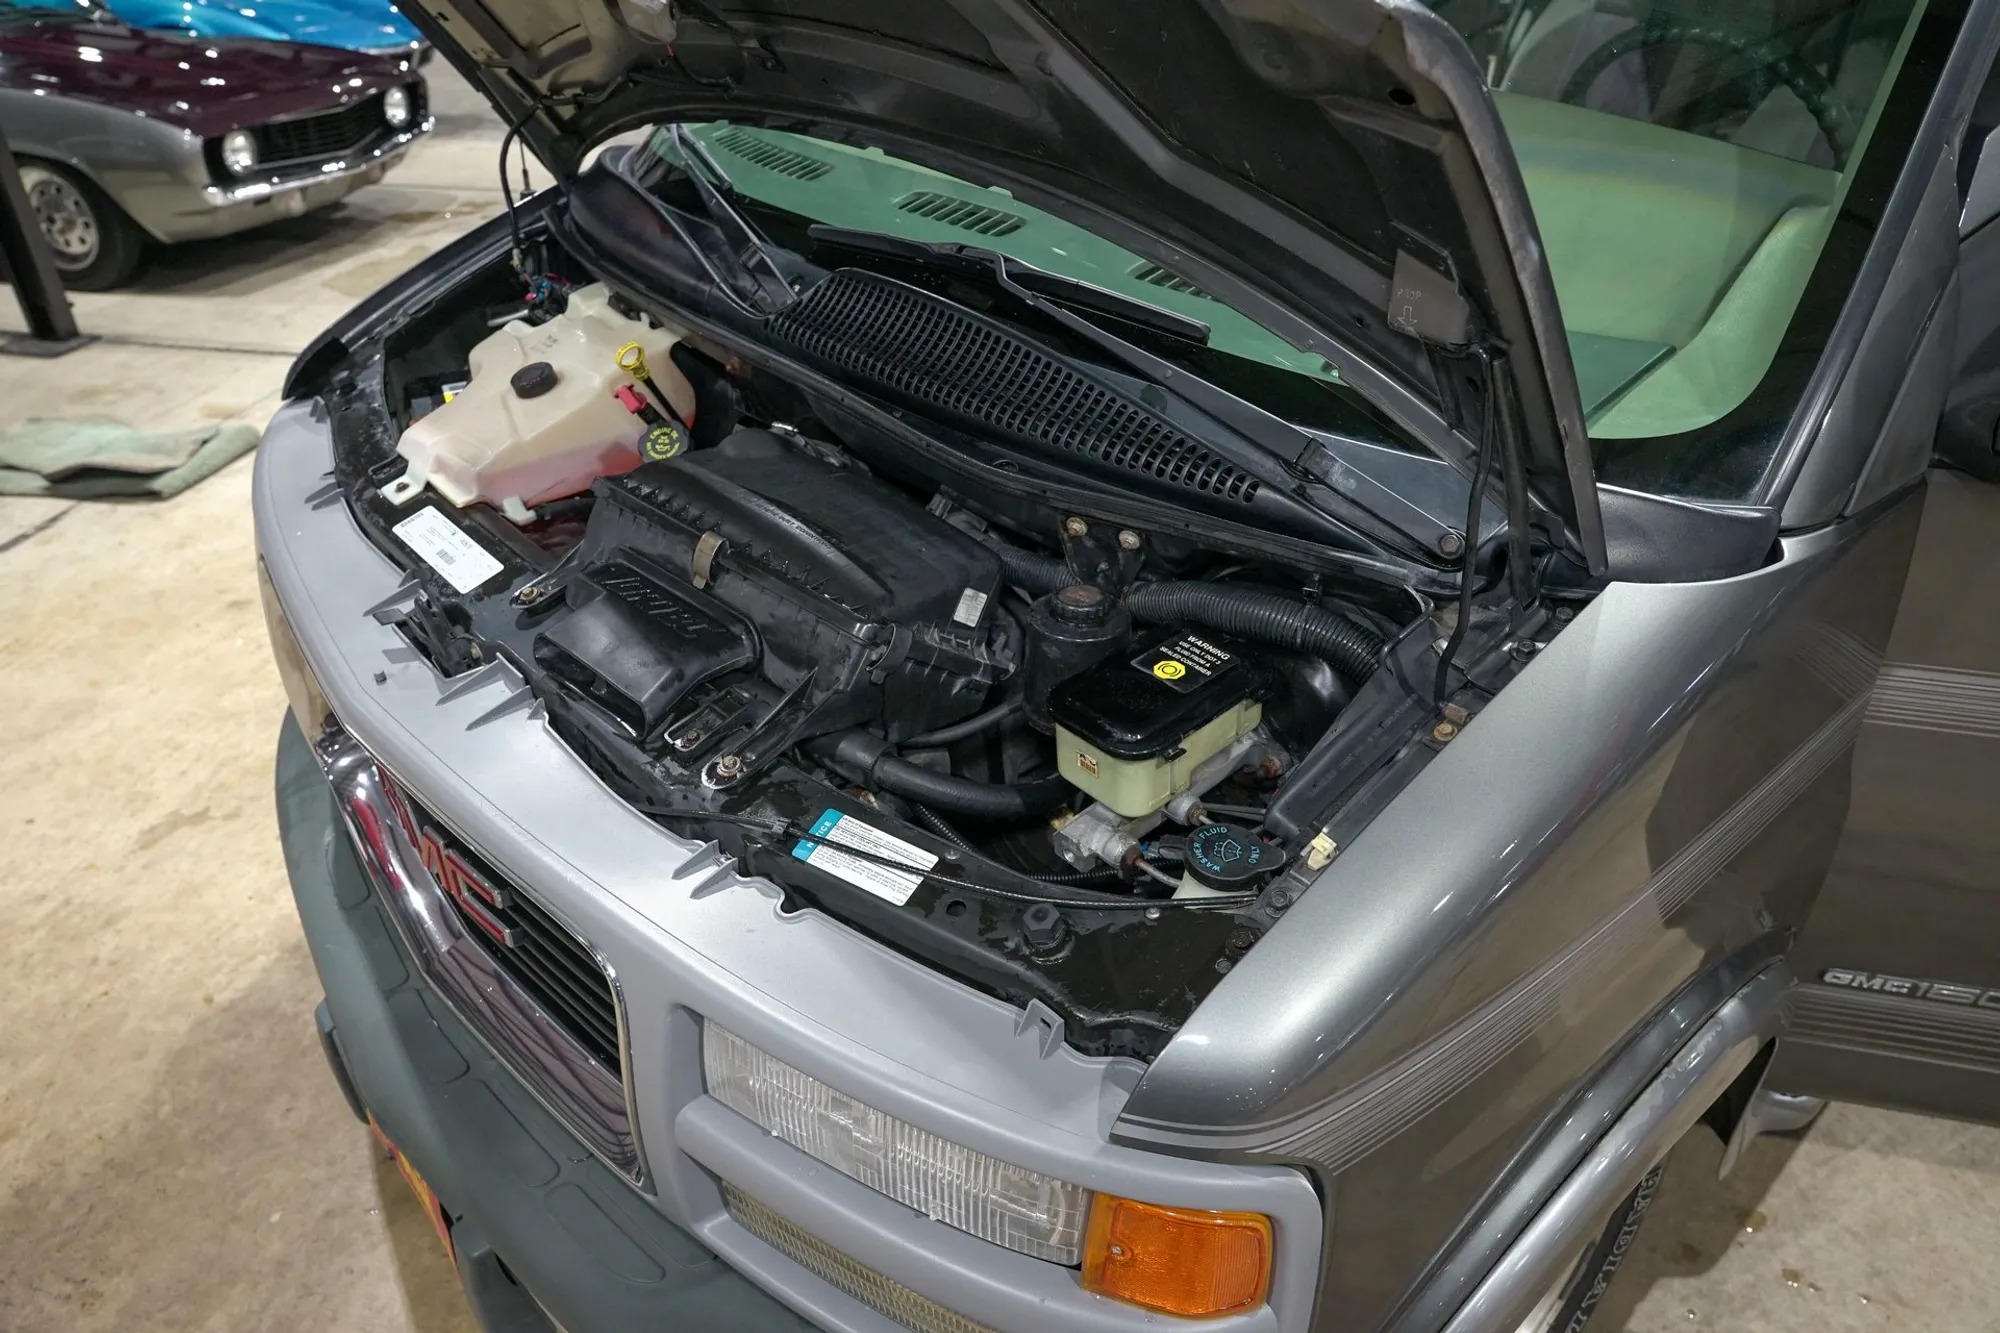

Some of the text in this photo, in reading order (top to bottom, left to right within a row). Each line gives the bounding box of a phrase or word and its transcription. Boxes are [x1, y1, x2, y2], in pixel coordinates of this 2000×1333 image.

[1159, 646, 1212, 677] SEALED CONTAINER
[1174, 646, 1191, 657] FLUID
[1190, 654, 1207, 665] FROM
[1179, 640, 1191, 649] USE
[1204, 654, 1217, 663] DOT
[1187, 635, 1231, 661] WARNING
[806, 820, 832, 849] NTICE
[1193, 826, 1261, 873] WASHER FLUID ONLY
